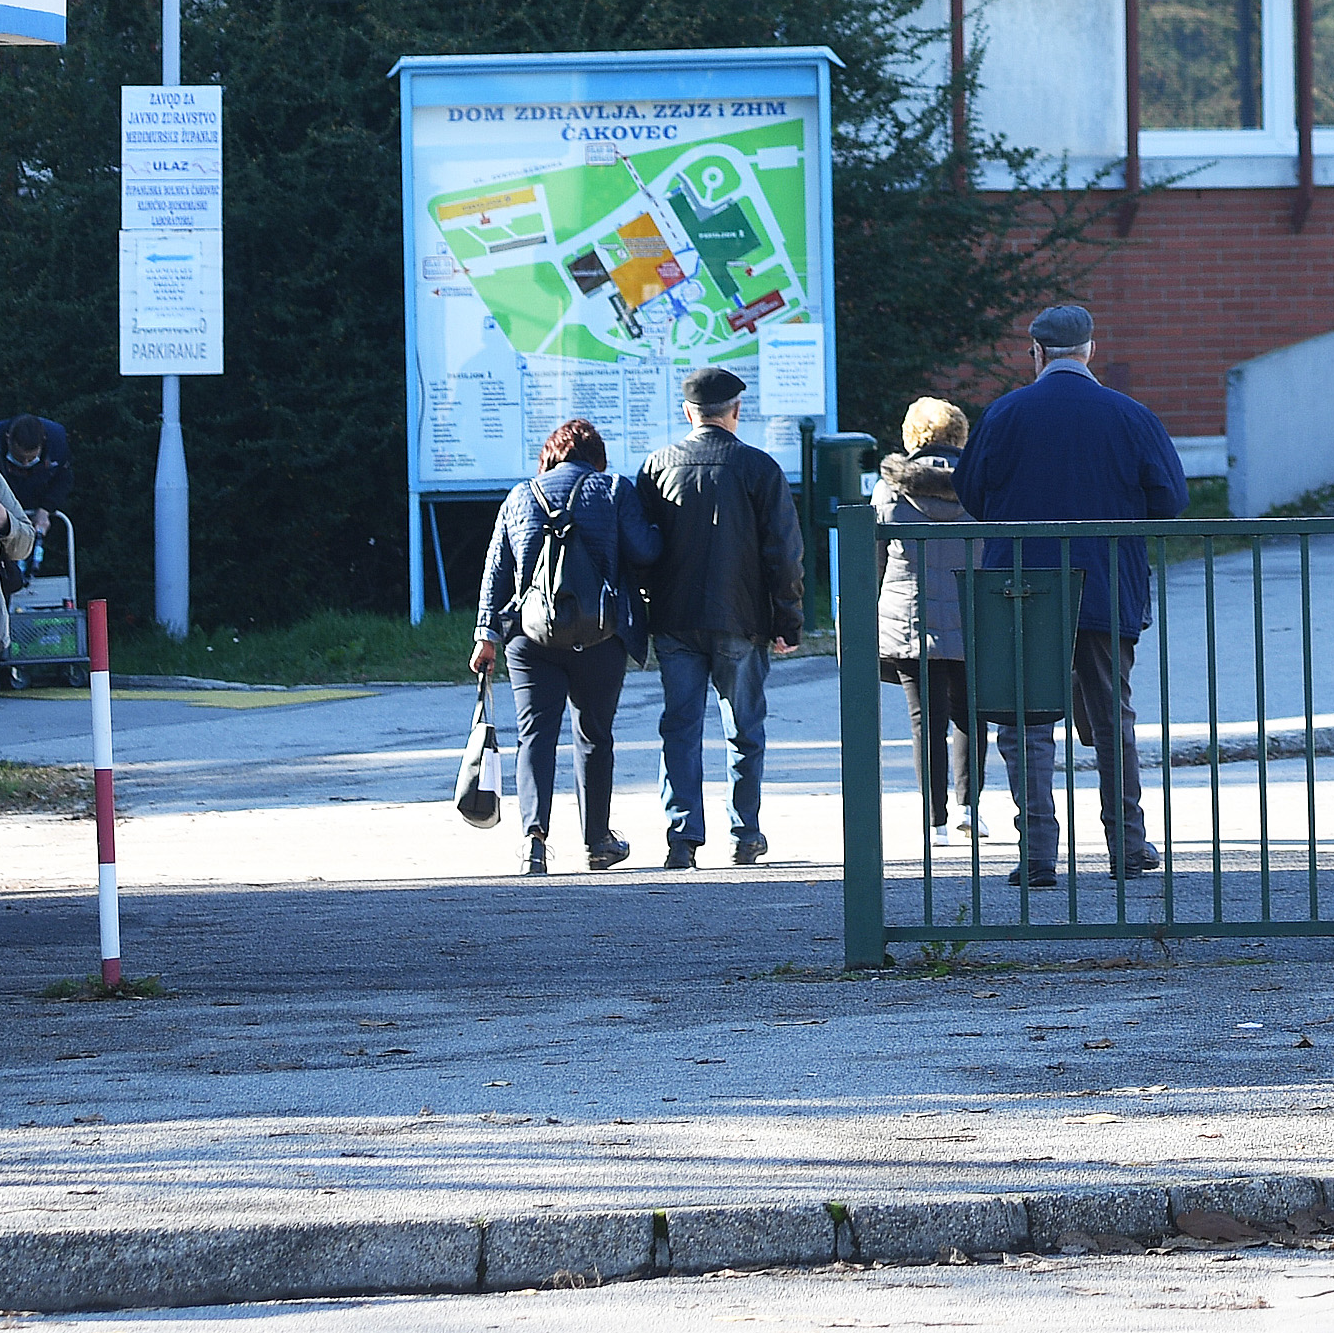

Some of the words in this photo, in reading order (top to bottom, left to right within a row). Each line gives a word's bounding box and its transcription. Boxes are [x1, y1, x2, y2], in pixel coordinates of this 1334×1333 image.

[149, 93, 181, 105] ZAVOD
[183, 93, 195, 105] ZA
[127, 112, 159, 124] JAVNO
[161, 112, 216, 124] ZDRAVSTVO
[448, 107, 505, 122] DOM
[514, 103, 646, 120] ZDRAVLJA,
[653, 102, 712, 119] ZZJZ
[731, 100, 788, 117] ZHM
[561, 123, 678, 141] ČAKOVEC
[153, 161, 190, 171] ULAZ
[131, 342, 207, 360] PARKIRANJE
